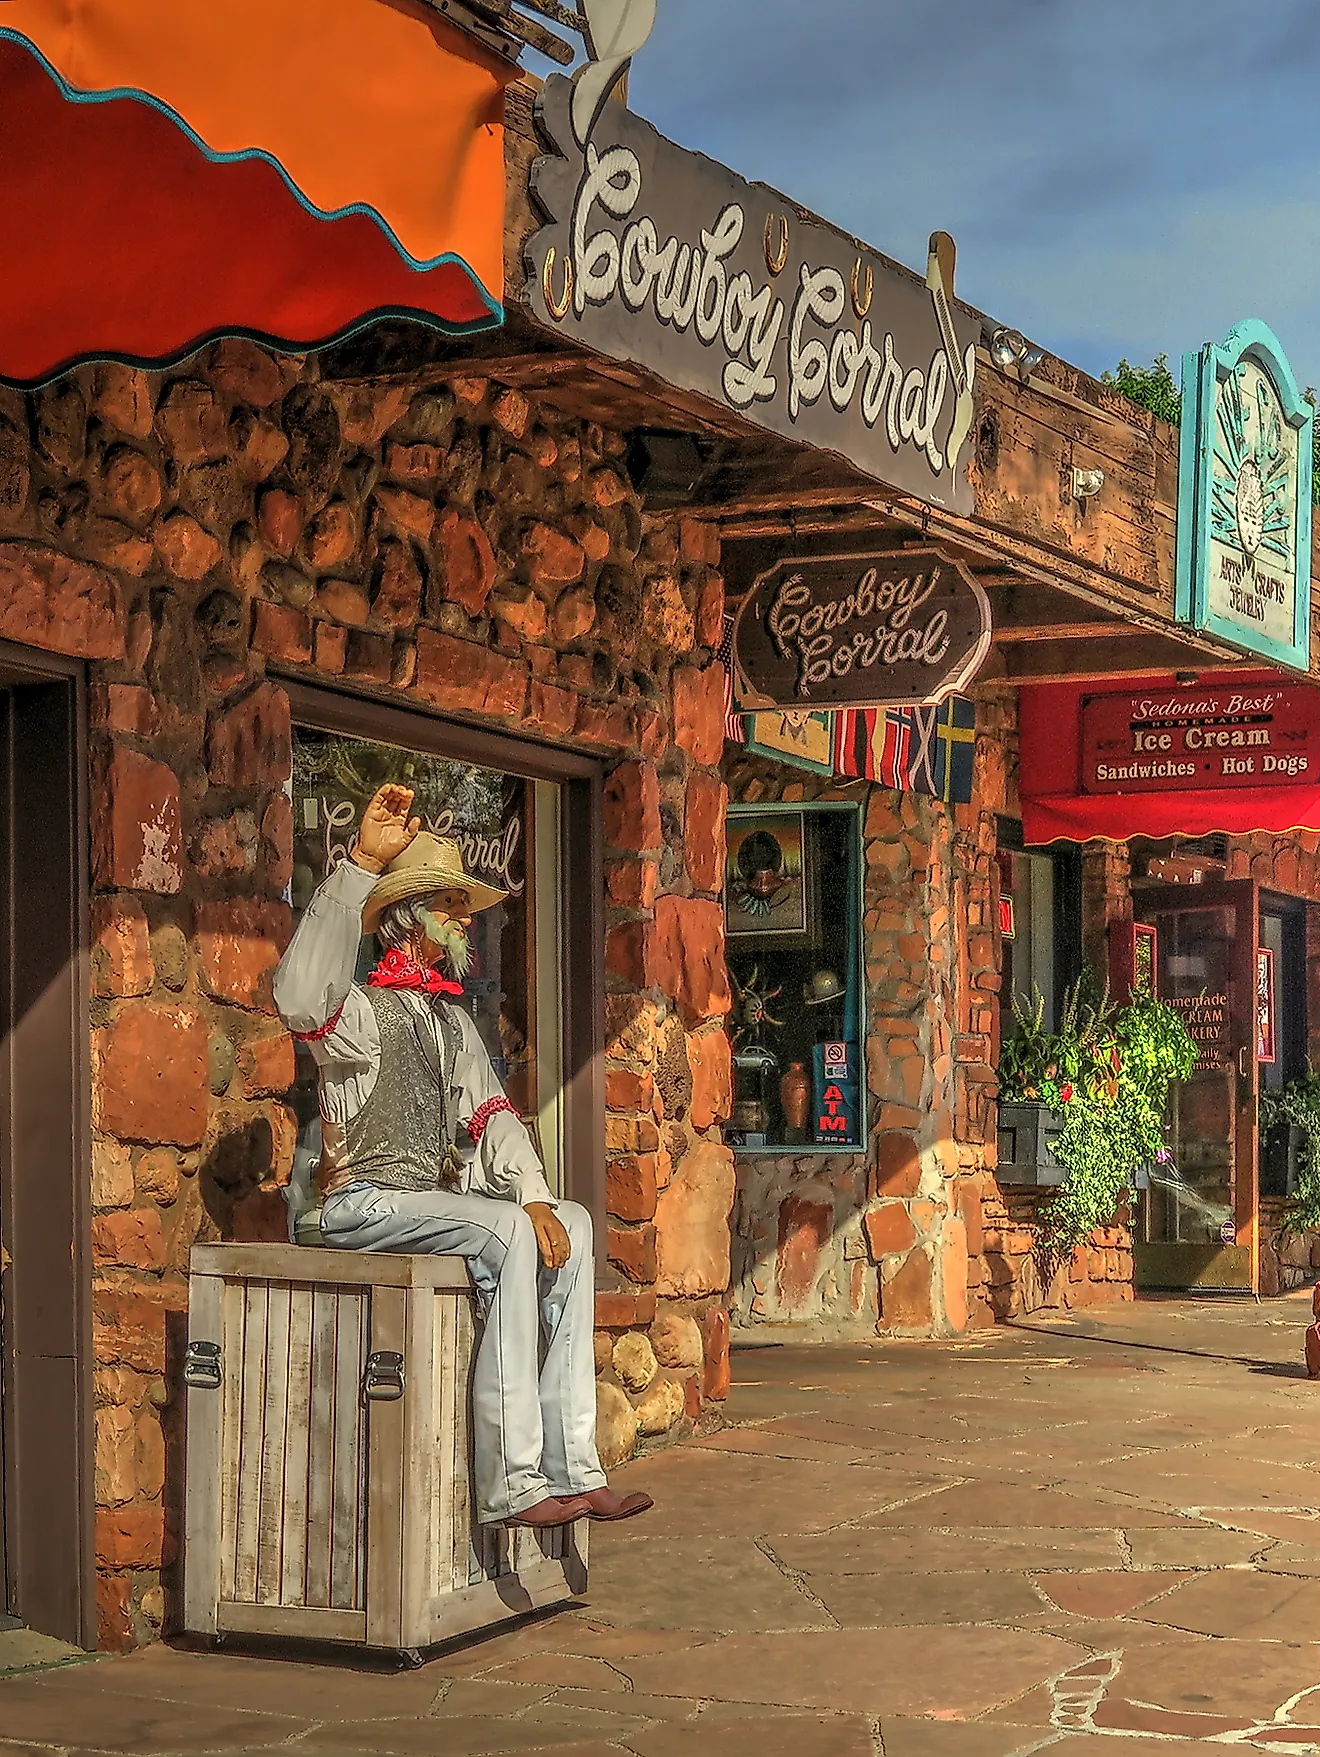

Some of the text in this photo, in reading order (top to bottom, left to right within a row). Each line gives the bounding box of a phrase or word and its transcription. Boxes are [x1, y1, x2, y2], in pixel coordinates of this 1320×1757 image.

[571, 141, 975, 476] Cowboy Corral
[1219, 555, 1286, 604] ARTS CRAFTS
[769, 566, 941, 659] Cowboy
[797, 609, 950, 696] Corral
[1133, 727, 1270, 751] Ice Cream
[1152, 716, 1250, 727] HOMEMADE
[1096, 754, 1308, 781] Sandwiches Hot Dogs
[1160, 993, 1228, 1008] omemade
[819, 1085, 848, 1131] ATM
